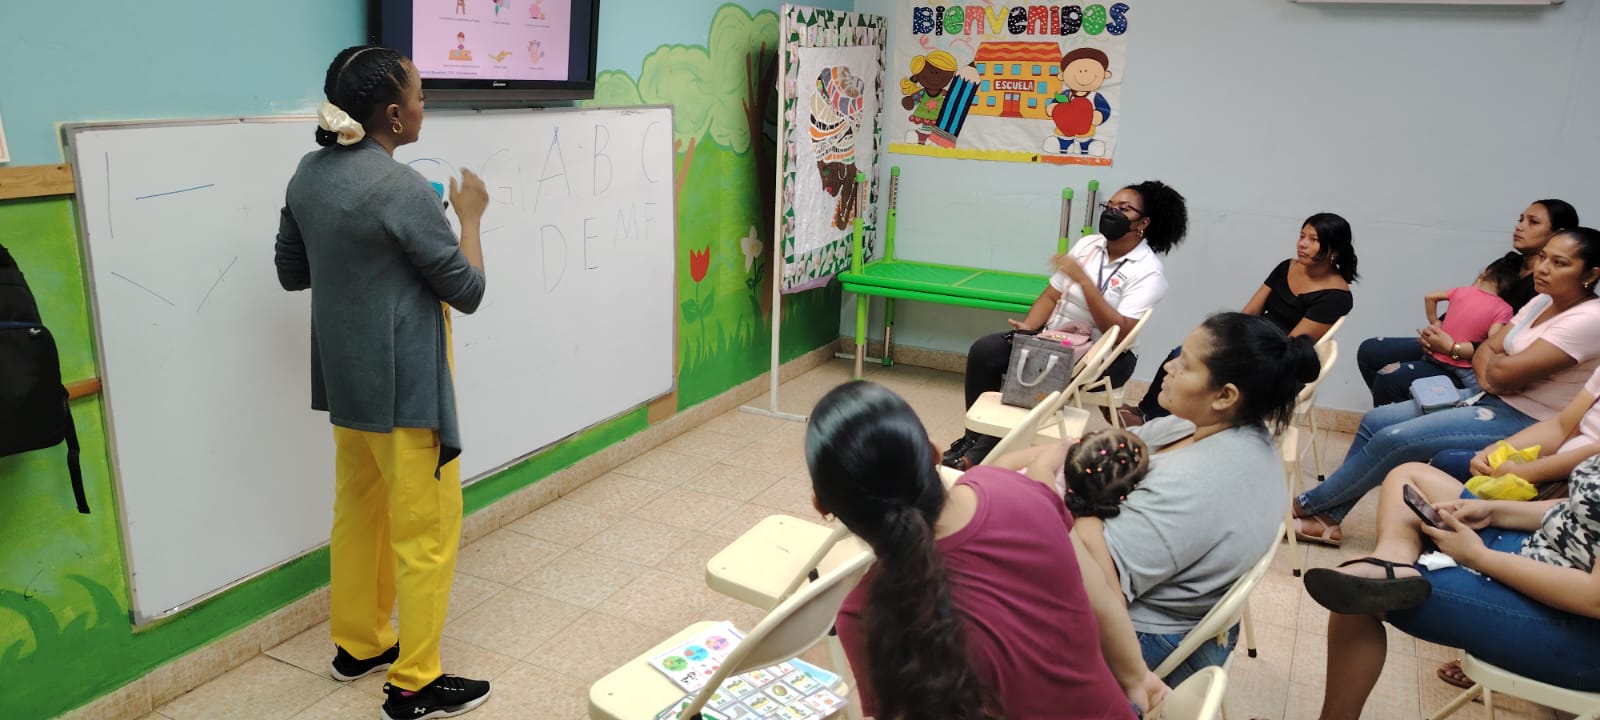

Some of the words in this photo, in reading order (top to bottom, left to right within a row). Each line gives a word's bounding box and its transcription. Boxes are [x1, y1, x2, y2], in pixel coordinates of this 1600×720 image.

[995, 80, 1034, 91] ESCUELA
[533, 125, 572, 214] A
[593, 123, 614, 198] B
[641, 120, 662, 184] C
[539, 223, 568, 295] D
[583, 216, 600, 272] E
